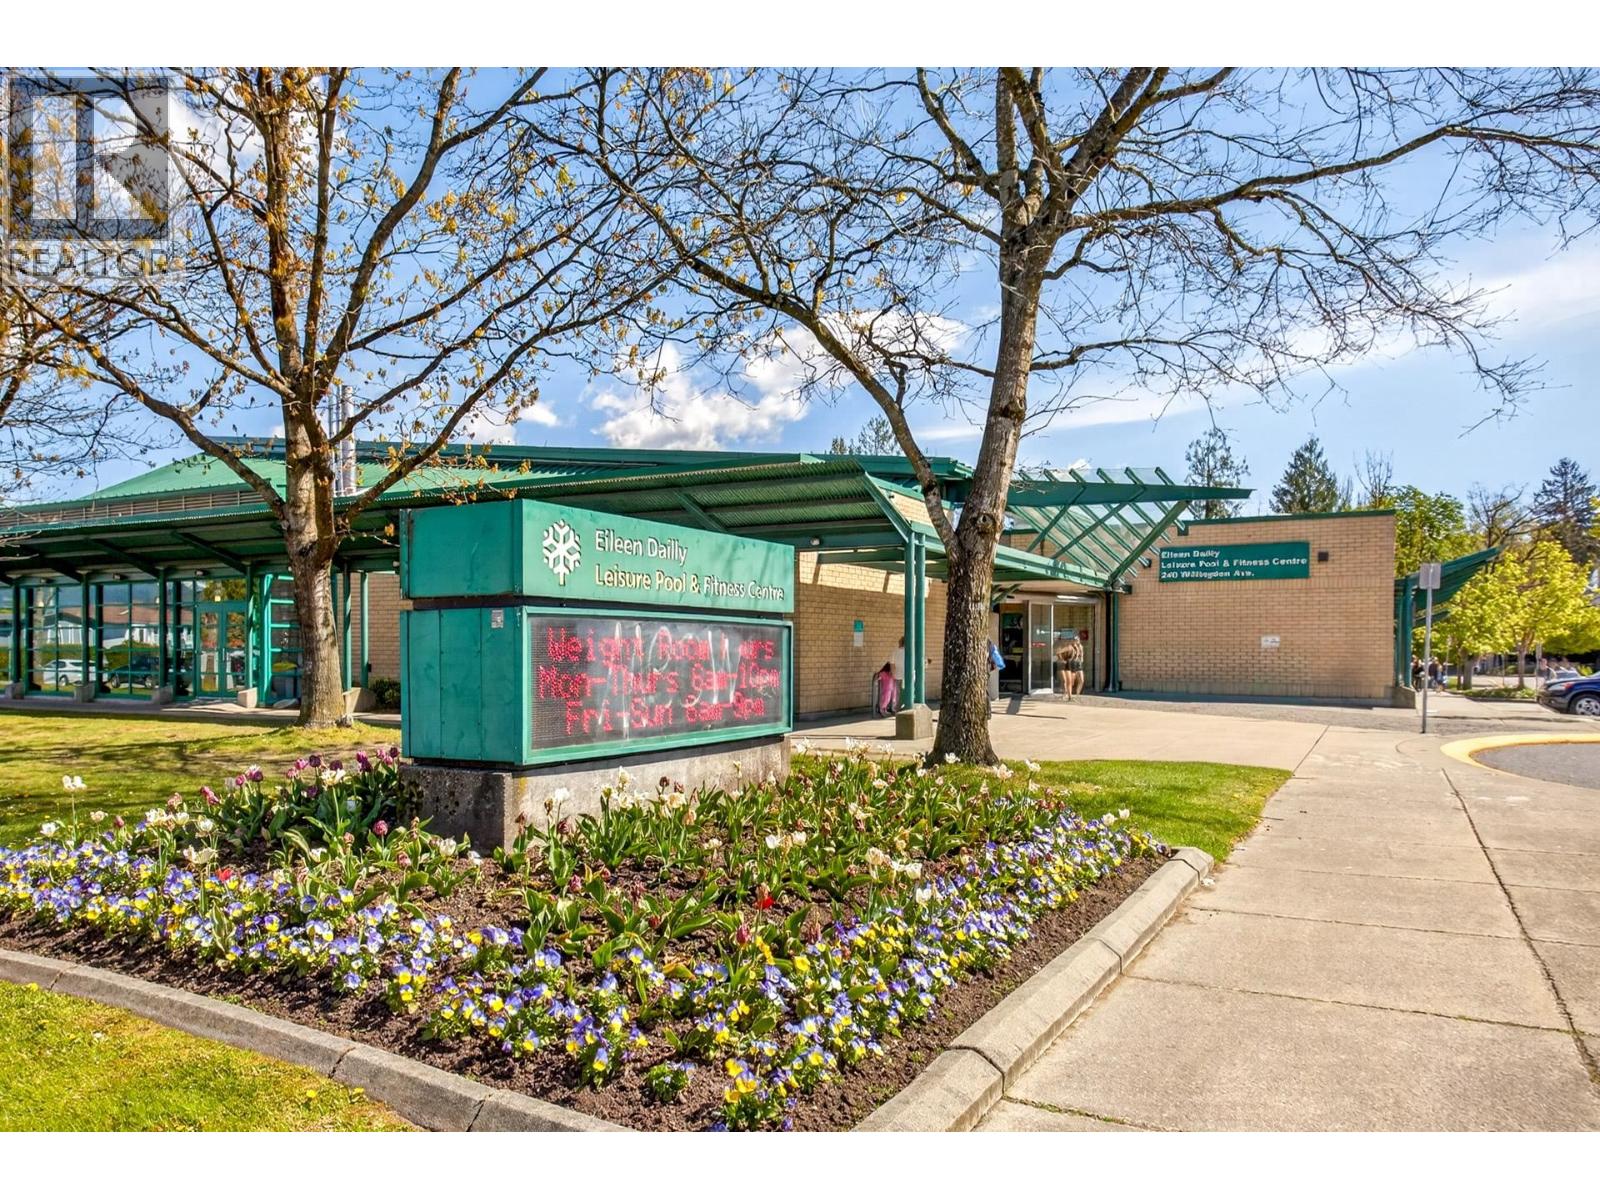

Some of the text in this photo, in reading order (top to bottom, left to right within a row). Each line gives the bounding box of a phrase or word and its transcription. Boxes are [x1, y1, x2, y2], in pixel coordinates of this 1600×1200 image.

[594, 528, 688, 567] Eileen Dailly
[1161, 550, 1191, 559] Eileen
[1161, 556, 1308, 569] Leisure Pool & Fitness Centre
[594, 563, 784, 601] Leisure Pool & Fitness Centre
[547, 626, 645, 668] Weight
[720, 632, 775, 661] urs
